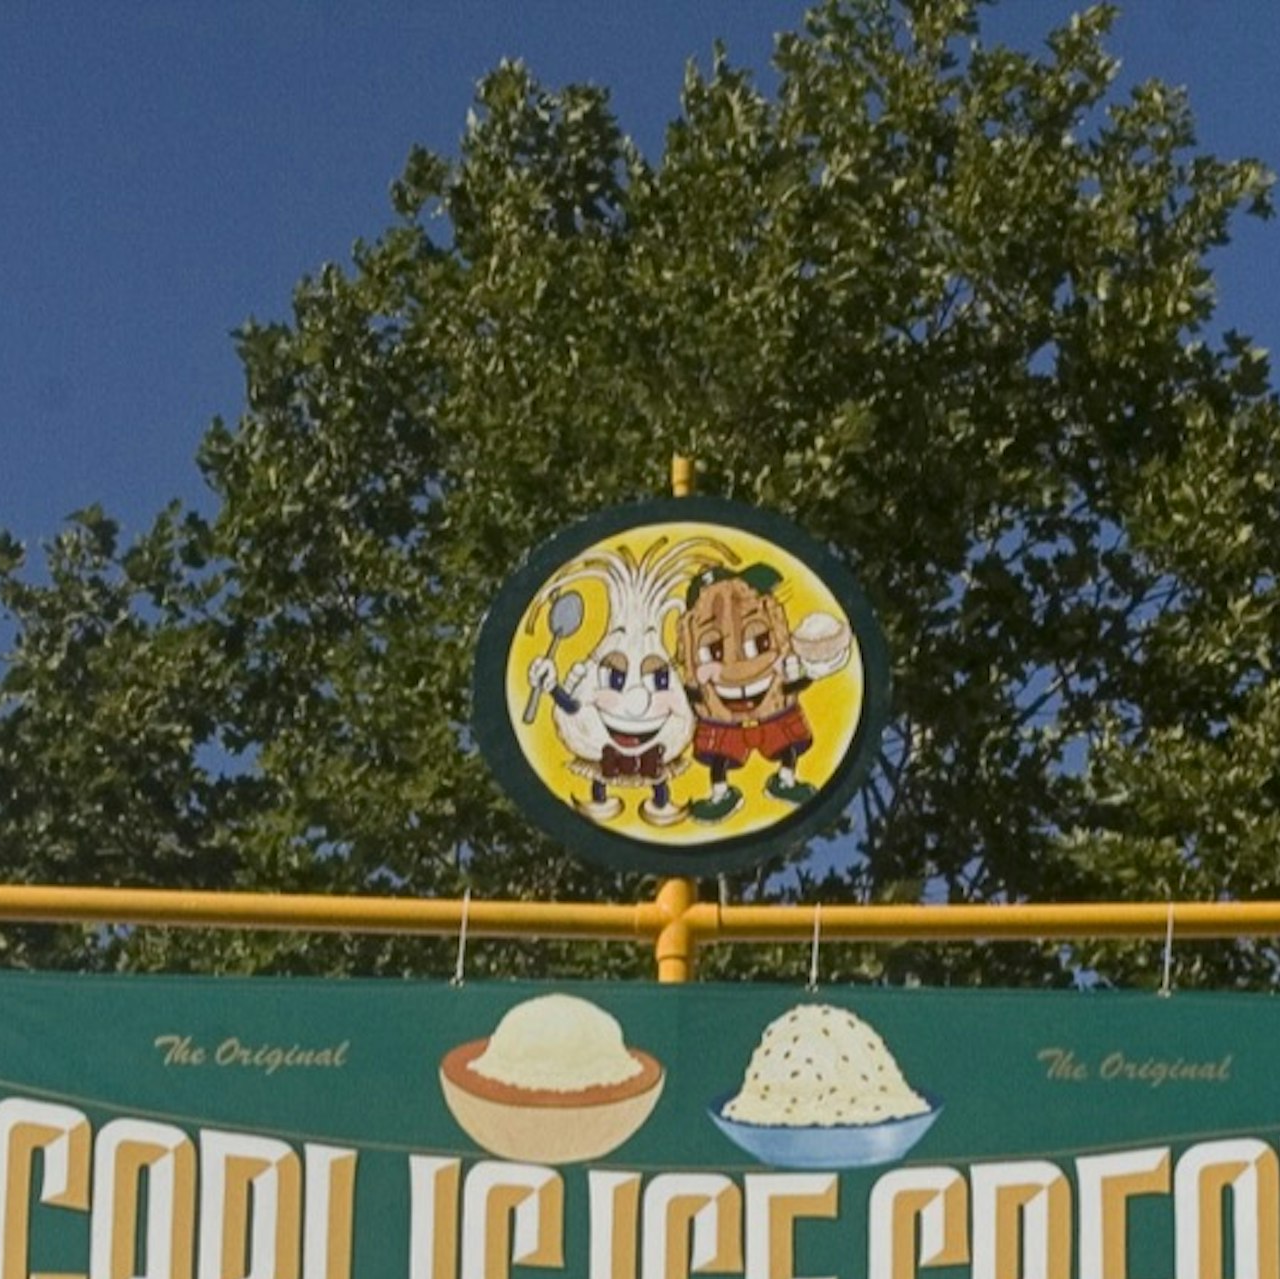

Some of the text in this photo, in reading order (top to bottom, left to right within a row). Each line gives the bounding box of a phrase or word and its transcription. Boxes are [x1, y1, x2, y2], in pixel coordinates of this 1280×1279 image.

[154, 1034, 350, 1076] The Original
[1036, 1047, 1232, 1087] The Original
